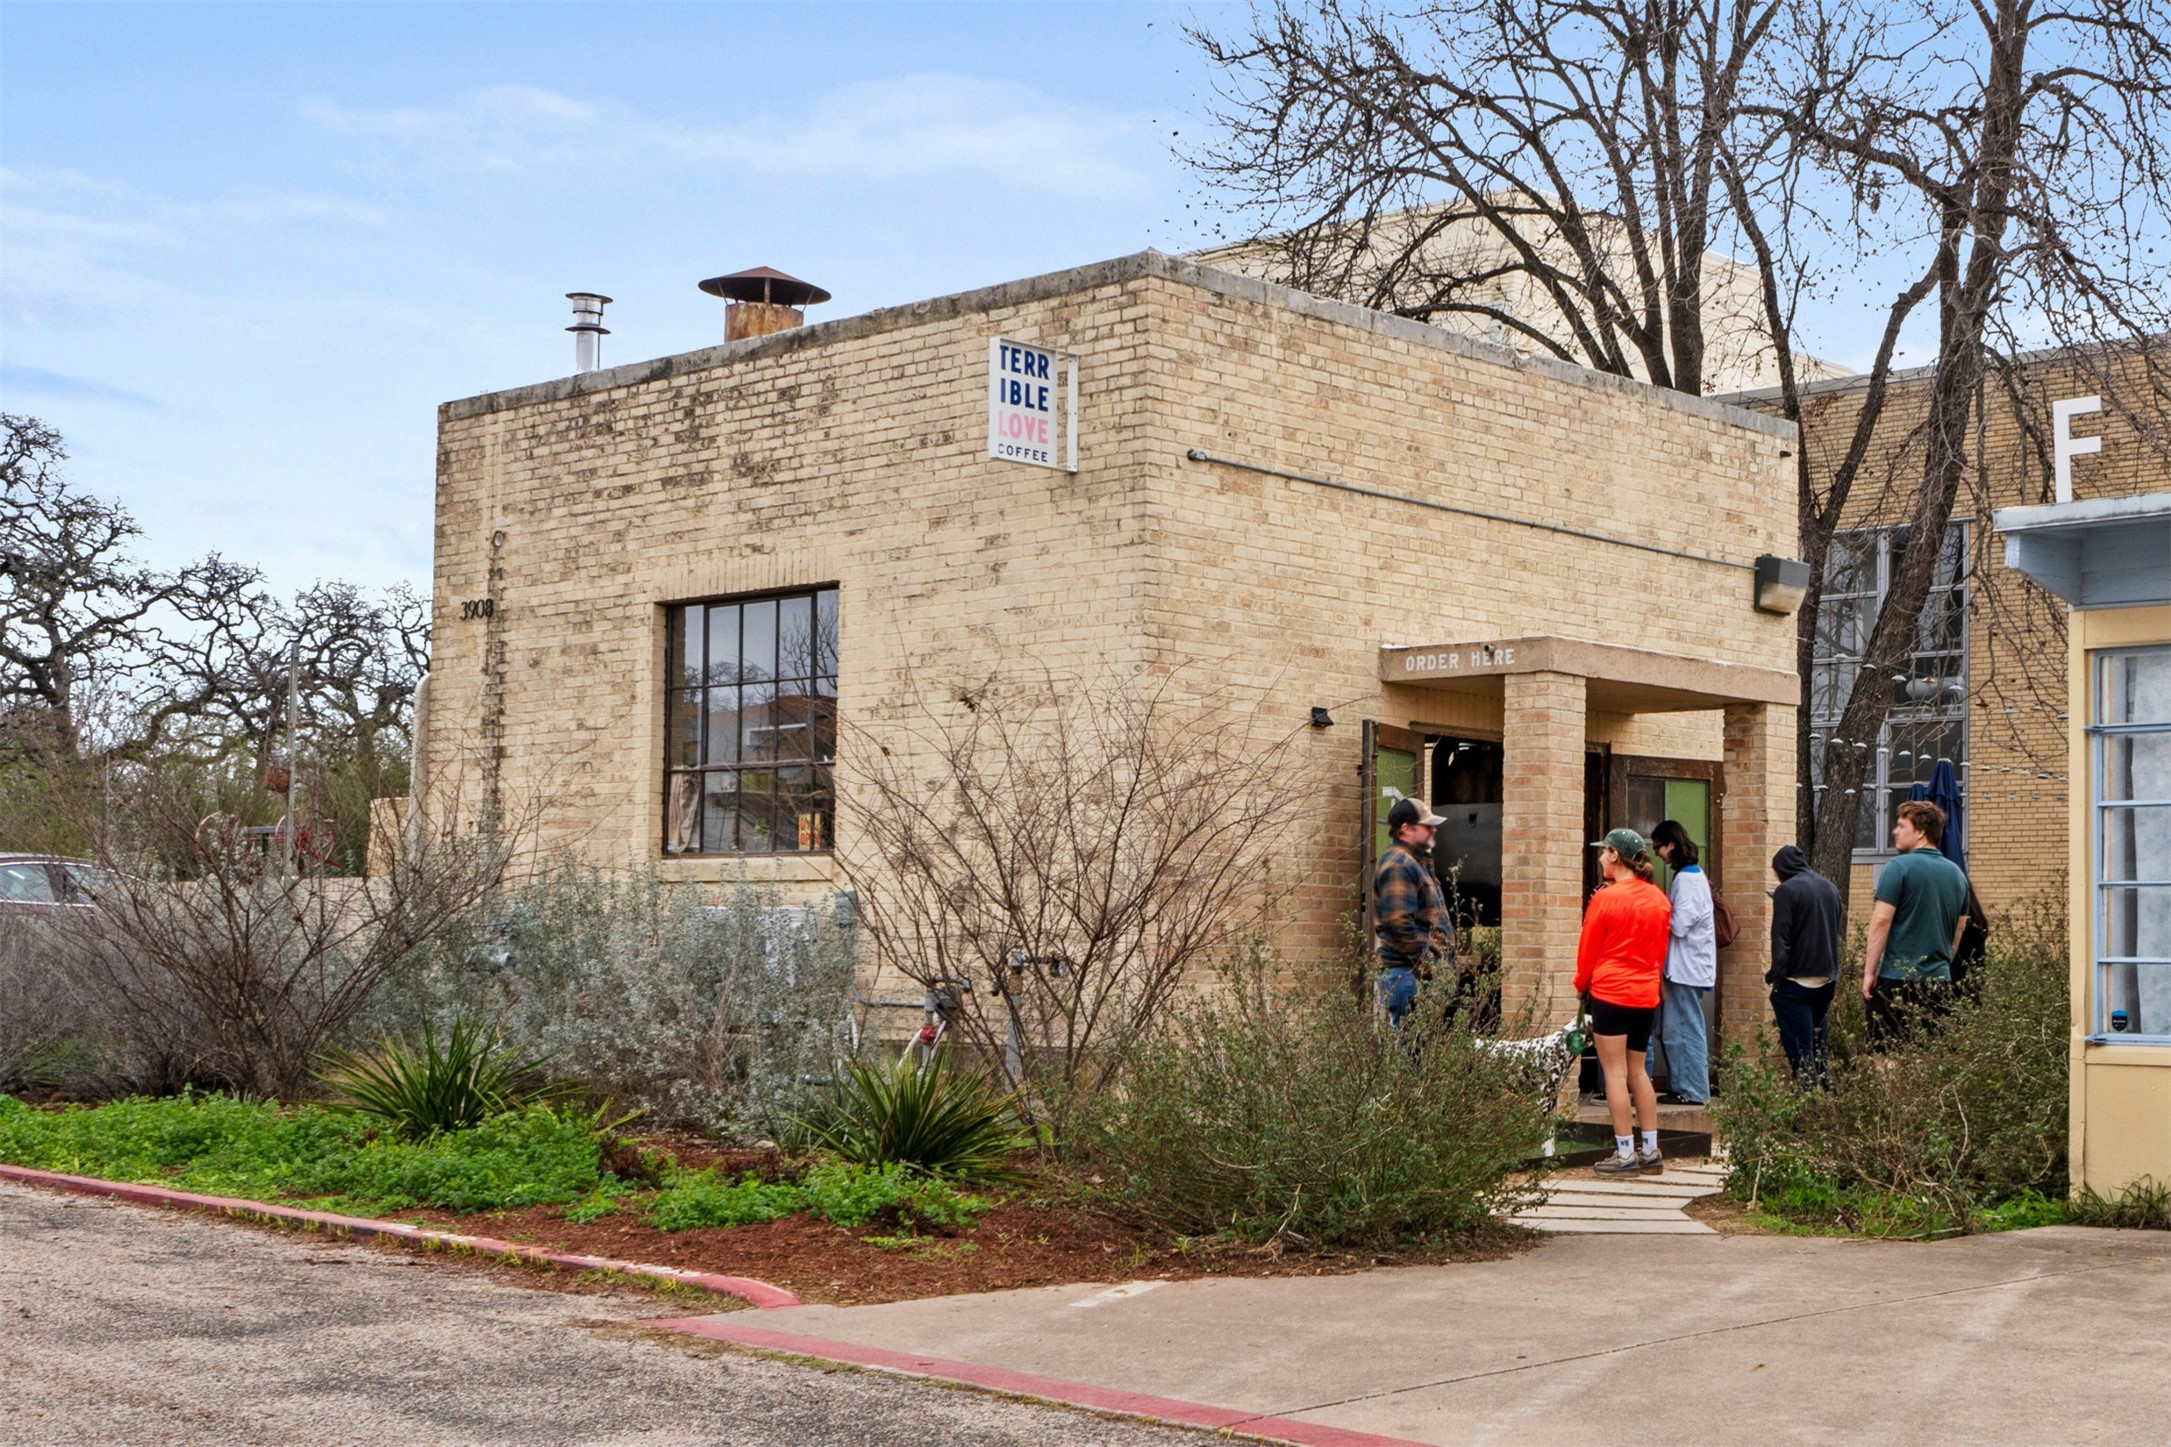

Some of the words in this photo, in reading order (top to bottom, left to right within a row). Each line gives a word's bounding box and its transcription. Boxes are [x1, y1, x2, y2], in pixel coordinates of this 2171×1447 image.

[999, 344, 1049, 380] TERR
[1000, 378, 1049, 412] IBLE
[998, 410, 1049, 444] LOVE
[998, 443, 1048, 462] COFFEE
[2053, 395, 2102, 503] F
[459, 598, 494, 621] 3908
[1405, 653, 1460, 671] ORDER
[1471, 648, 1515, 667] HERE
